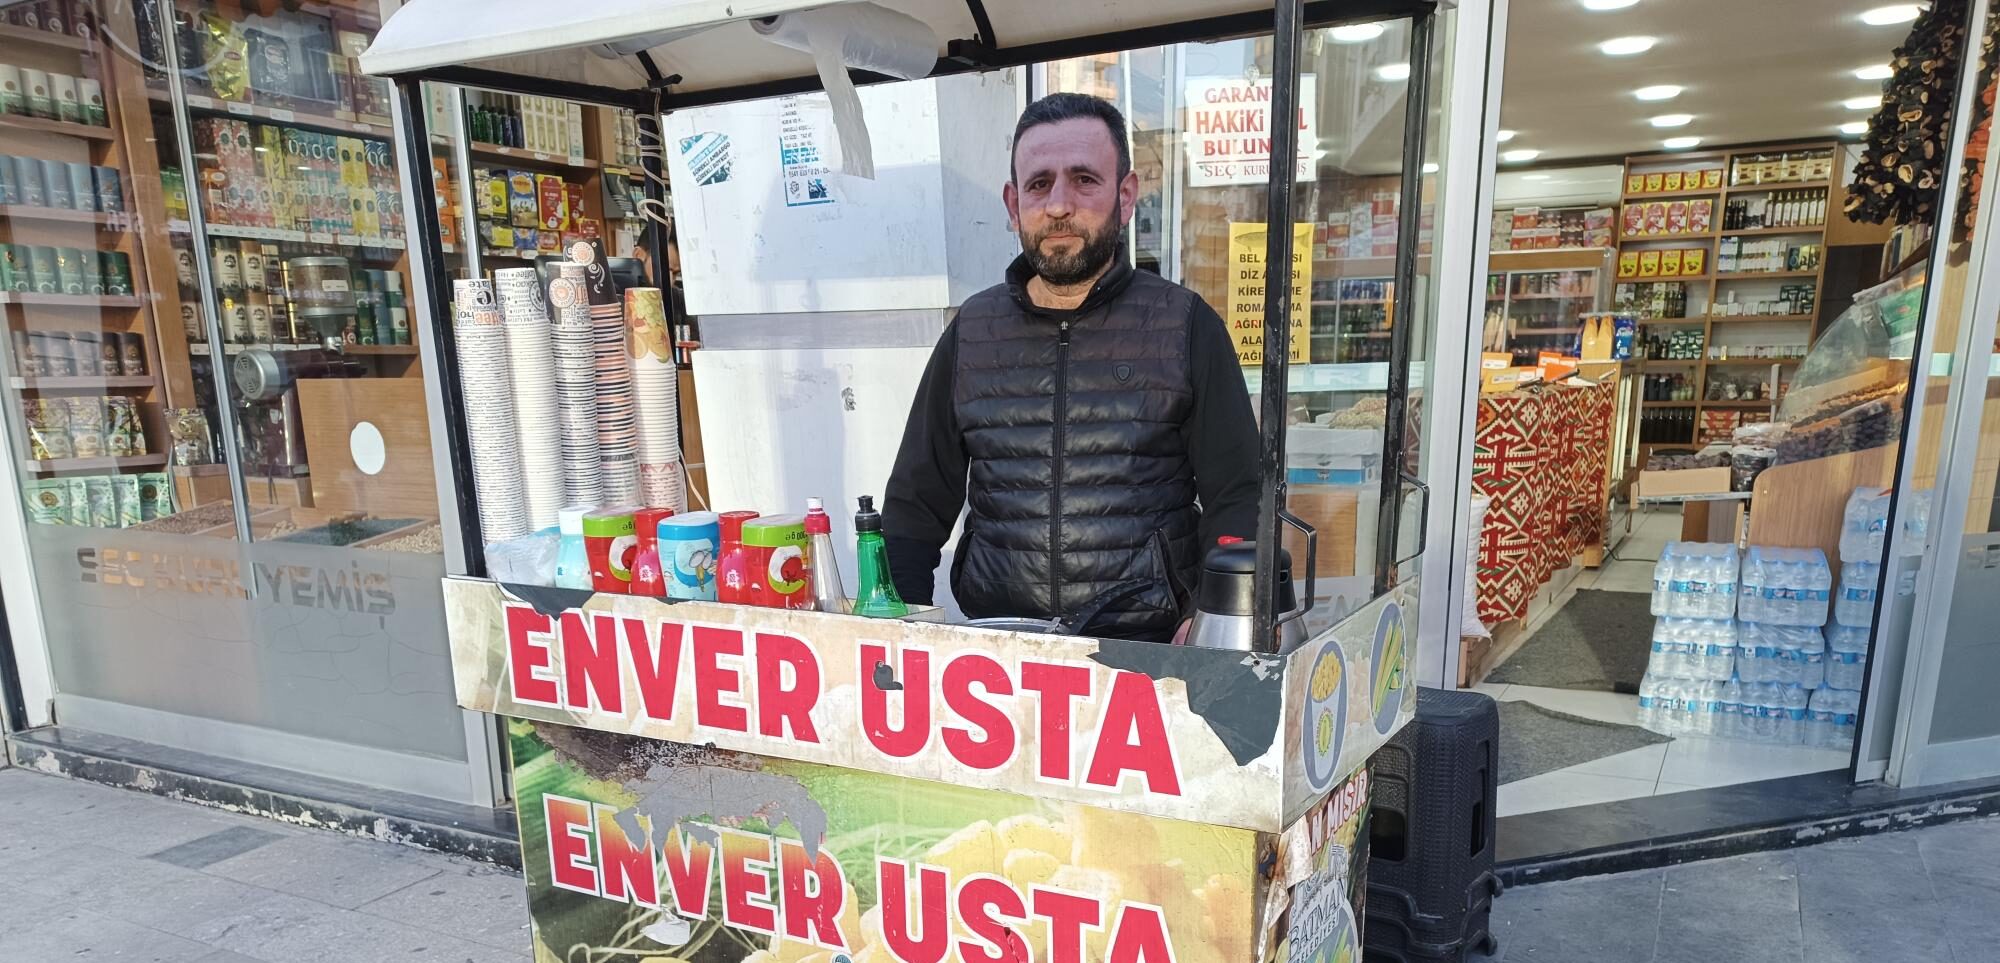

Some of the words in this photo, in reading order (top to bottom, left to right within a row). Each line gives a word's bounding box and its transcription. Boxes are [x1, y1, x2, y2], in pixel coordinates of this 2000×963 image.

[1204, 86, 1273, 104] GARAN
[1204, 164, 1236, 179] SEÇ
[1239, 253, 1260, 263] BEL
[1240, 268, 1259, 280] DİZ
[504, 604, 823, 746] ENVER
[858, 642, 1183, 798] USTA
[545, 796, 849, 951] ENVER
